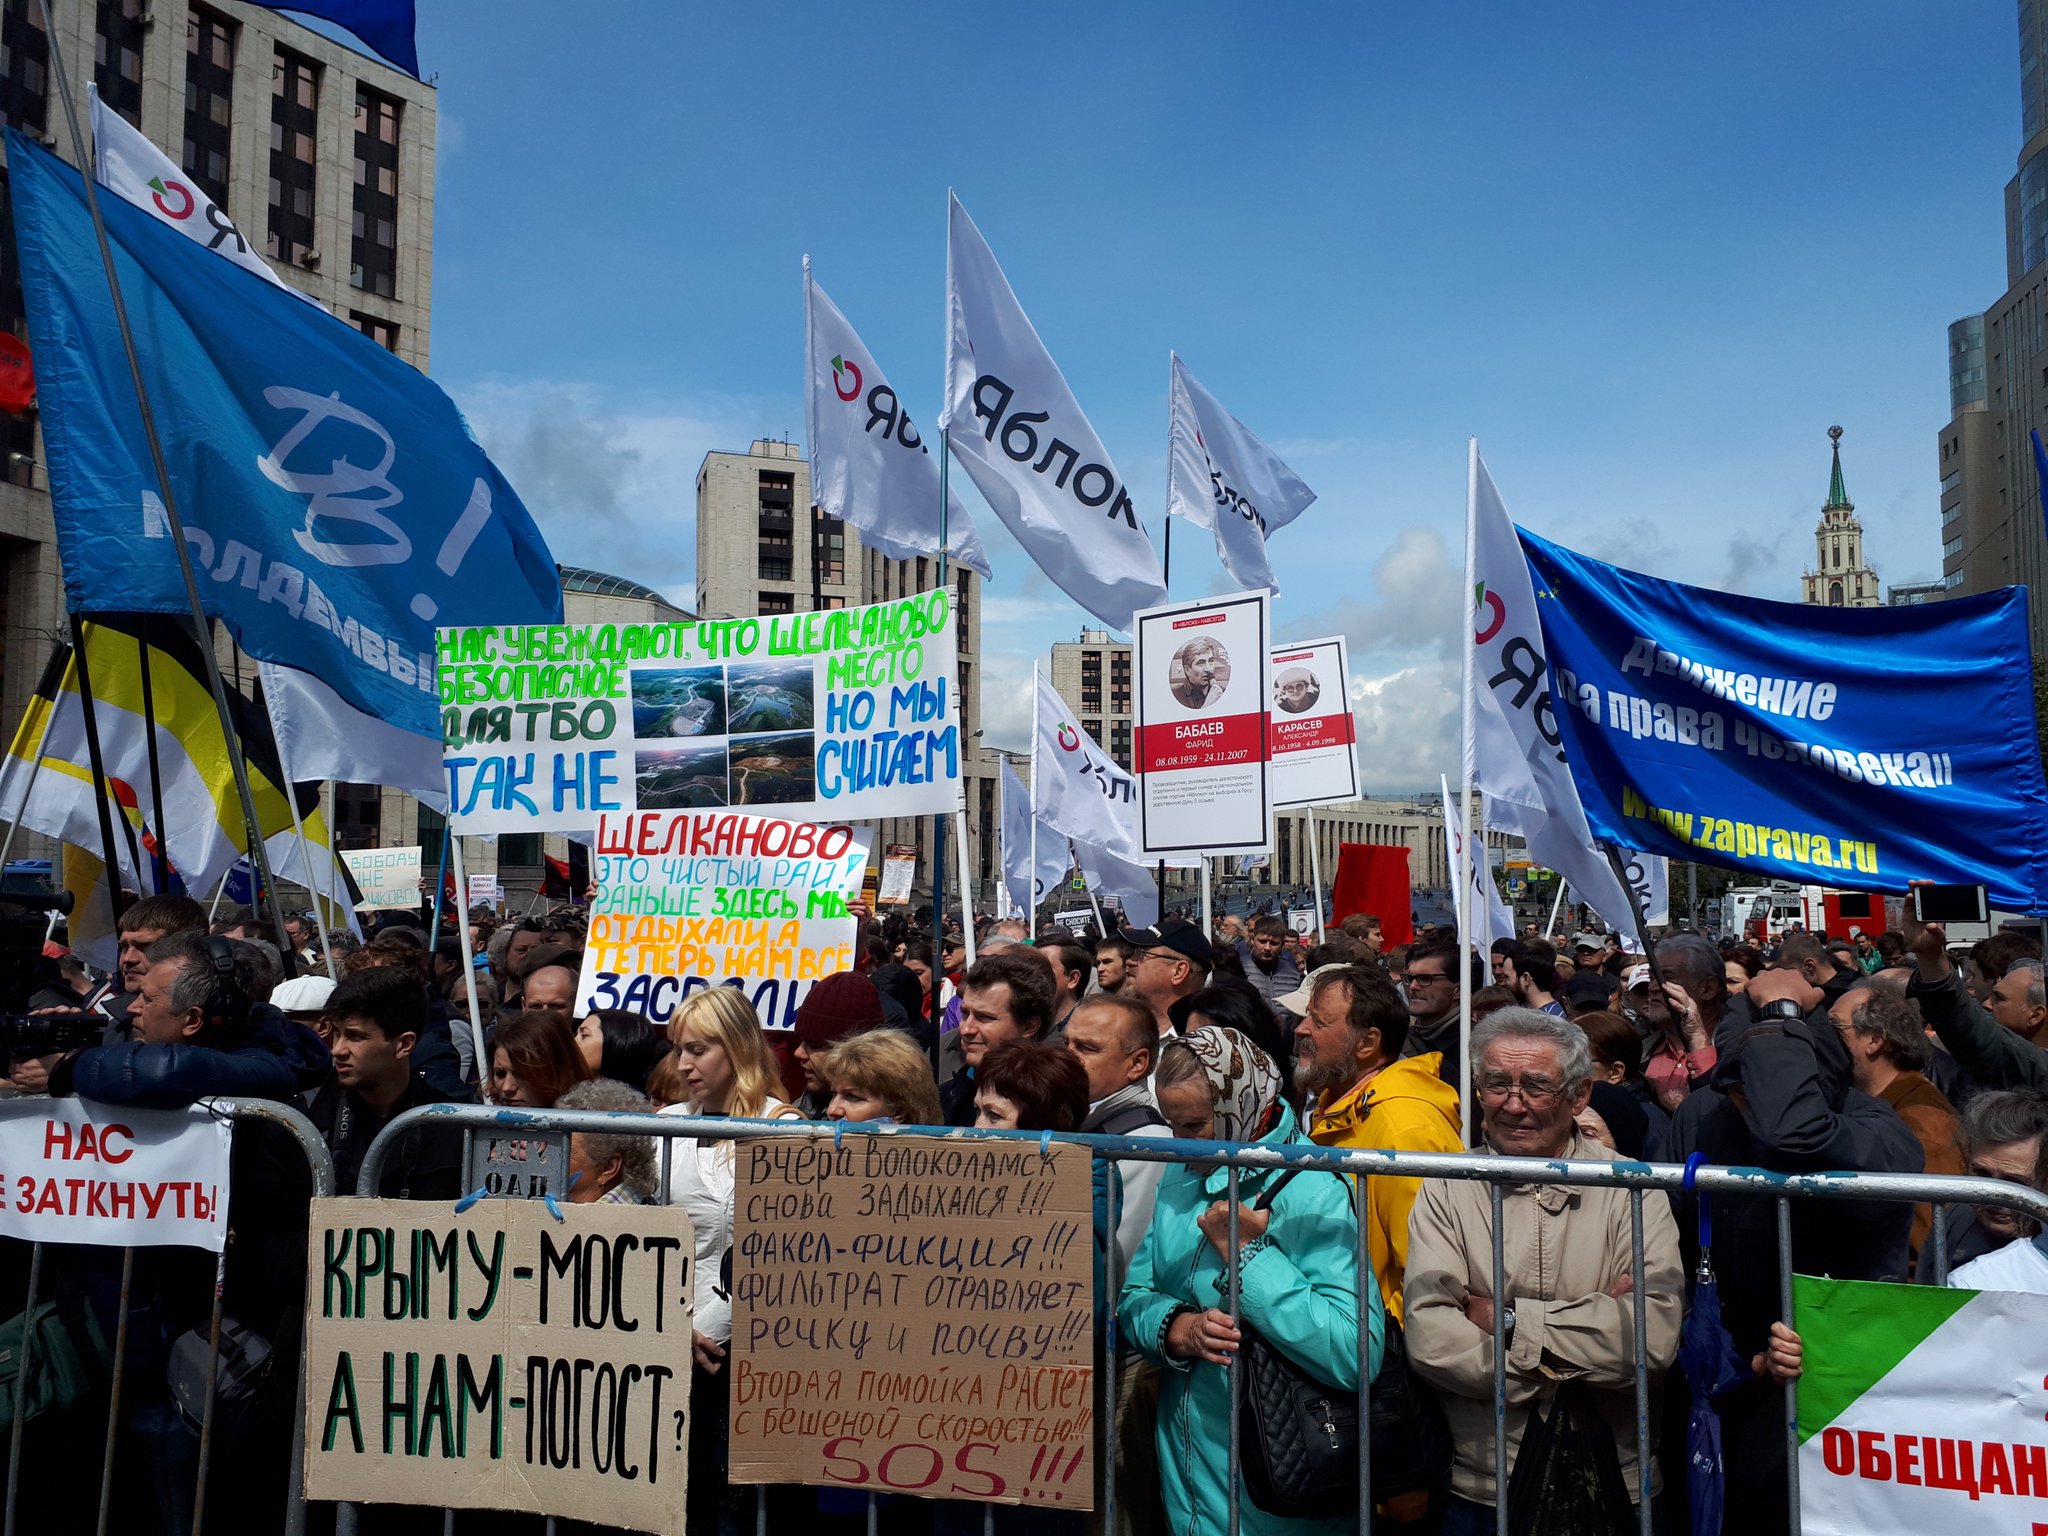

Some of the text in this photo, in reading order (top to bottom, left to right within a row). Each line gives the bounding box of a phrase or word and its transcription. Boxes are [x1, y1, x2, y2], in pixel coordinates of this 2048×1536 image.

[973, 374, 1148, 537] Яблок
[437, 589, 949, 664] НАС УБЕЖДАЮТ, ЧТО ЩЕЛКАНОВО
[438, 640, 924, 706] БЕЗОПАСНОЕ МЕСТО
[1621, 635, 1838, 722] Движение
[442, 676, 946, 752] ДЛЯ ТБО НО МЫ
[1175, 721, 1225, 739] БАБАЕВ
[1277, 719, 1323, 734] КАРАСЕВ
[1607, 690, 1724, 751] права
[1185, 738, 1214, 749] ФАРИД
[1282, 730, 1320, 741] АЛЕКСАНДР
[1305, 736, 1337, 748] 4.09.1998
[443, 725, 958, 817] ТАК НЕ СЧИТАЕМ
[1155, 754, 1199, 767] 08.08.1959
[1203, 749, 1249, 763] 24.11.2007
[597, 812, 853, 860] ЩЕЛКАНОВО
[341, 852, 418, 869] ВОБОДУ
[597, 856, 650, 884] ЭТО
[661, 857, 762, 888] ЧИСТЫЙ
[772, 853, 866, 890] РАЙ!
[594, 883, 704, 917] РАНЬШЕ
[711, 886, 798, 922] ЗДЕСЬ
[776, 919, 801, 948] А
[587, 940, 852, 980] ТЕПЕРЬ НАМ ВСЁ
[43, 1120, 136, 1164] НАС
[340, 1106, 351, 1139] SONY
[16, 1175, 217, 1223] ЗАТКНУТЬ!
[737, 1269, 909, 1311] ФИЛЬТРАТ
[320, 1350, 365, 1454] А
